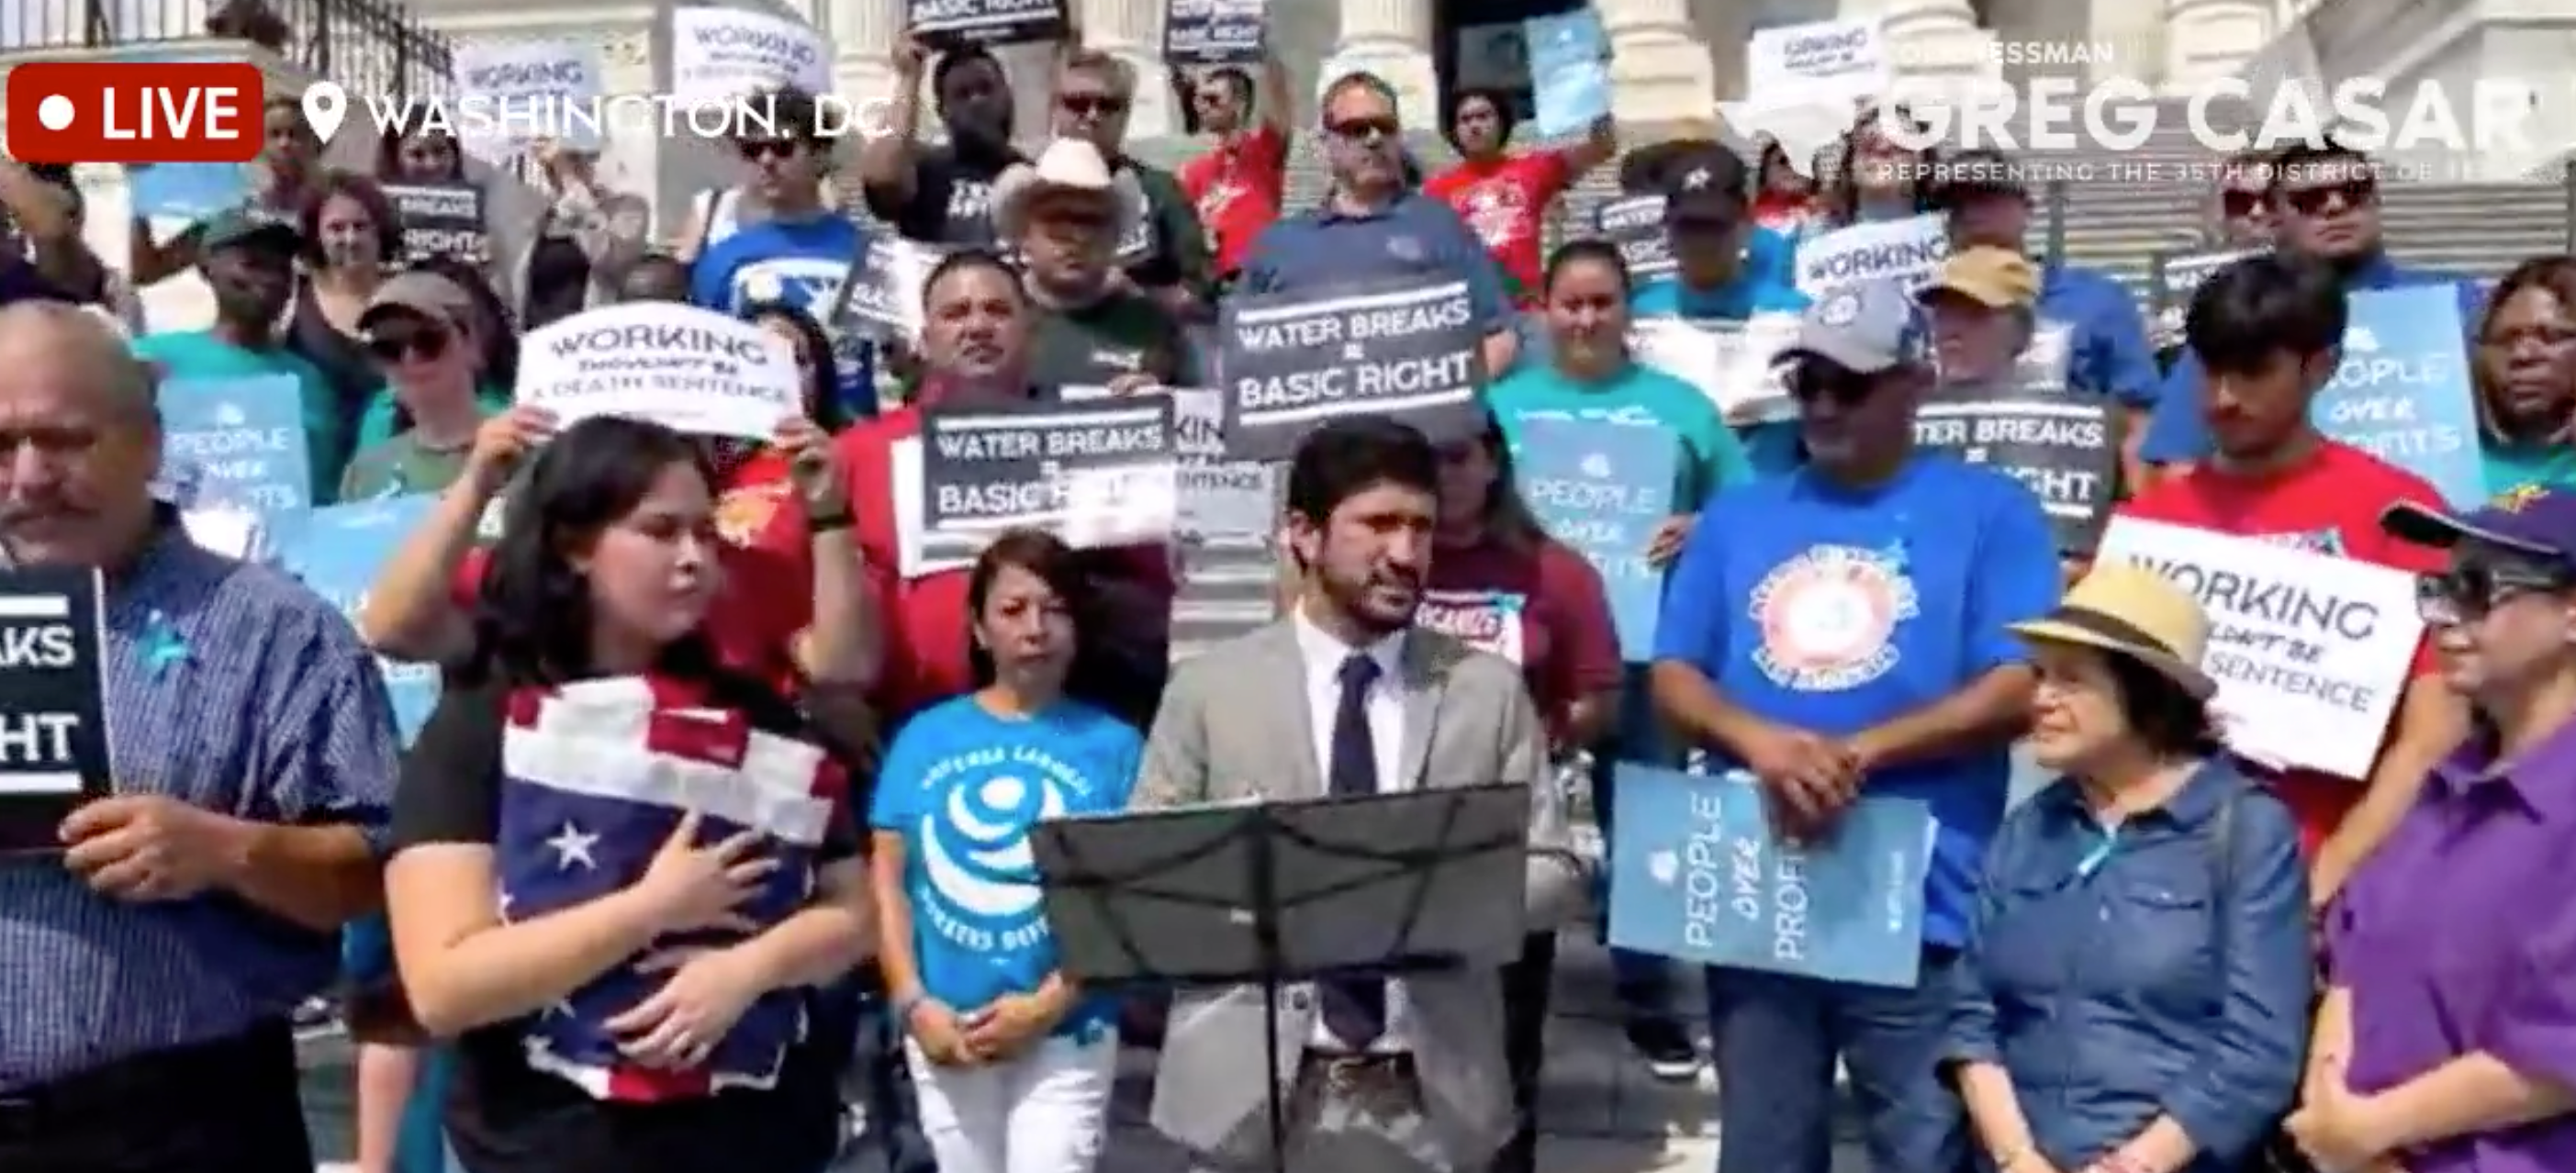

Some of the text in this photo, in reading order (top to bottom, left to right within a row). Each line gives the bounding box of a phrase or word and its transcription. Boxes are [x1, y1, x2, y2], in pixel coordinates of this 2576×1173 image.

[1238, 317, 1341, 352] WATER
[1350, 297, 1471, 340] BREAKS
[551, 324, 768, 365] WORKING
[551, 372, 644, 400] DEATH
[650, 372, 789, 403] SENTENCE
[1239, 350, 1473, 408] BASIC RIGHT
[2329, 395, 2418, 424] OVER
[169, 428, 290, 455] PEOPLE
[937, 423, 1163, 459] WATER BREAKS
[1976, 418, 2105, 448] BREAKS
[939, 480, 1040, 513] BASIC
[1531, 478, 1656, 515] PEOPLE
[2212, 649, 2375, 712] SENTENCE
[1685, 791, 1722, 948] PEOPLE
[1731, 835, 1764, 922] OVER
[1774, 837, 1809, 961] PROFI
